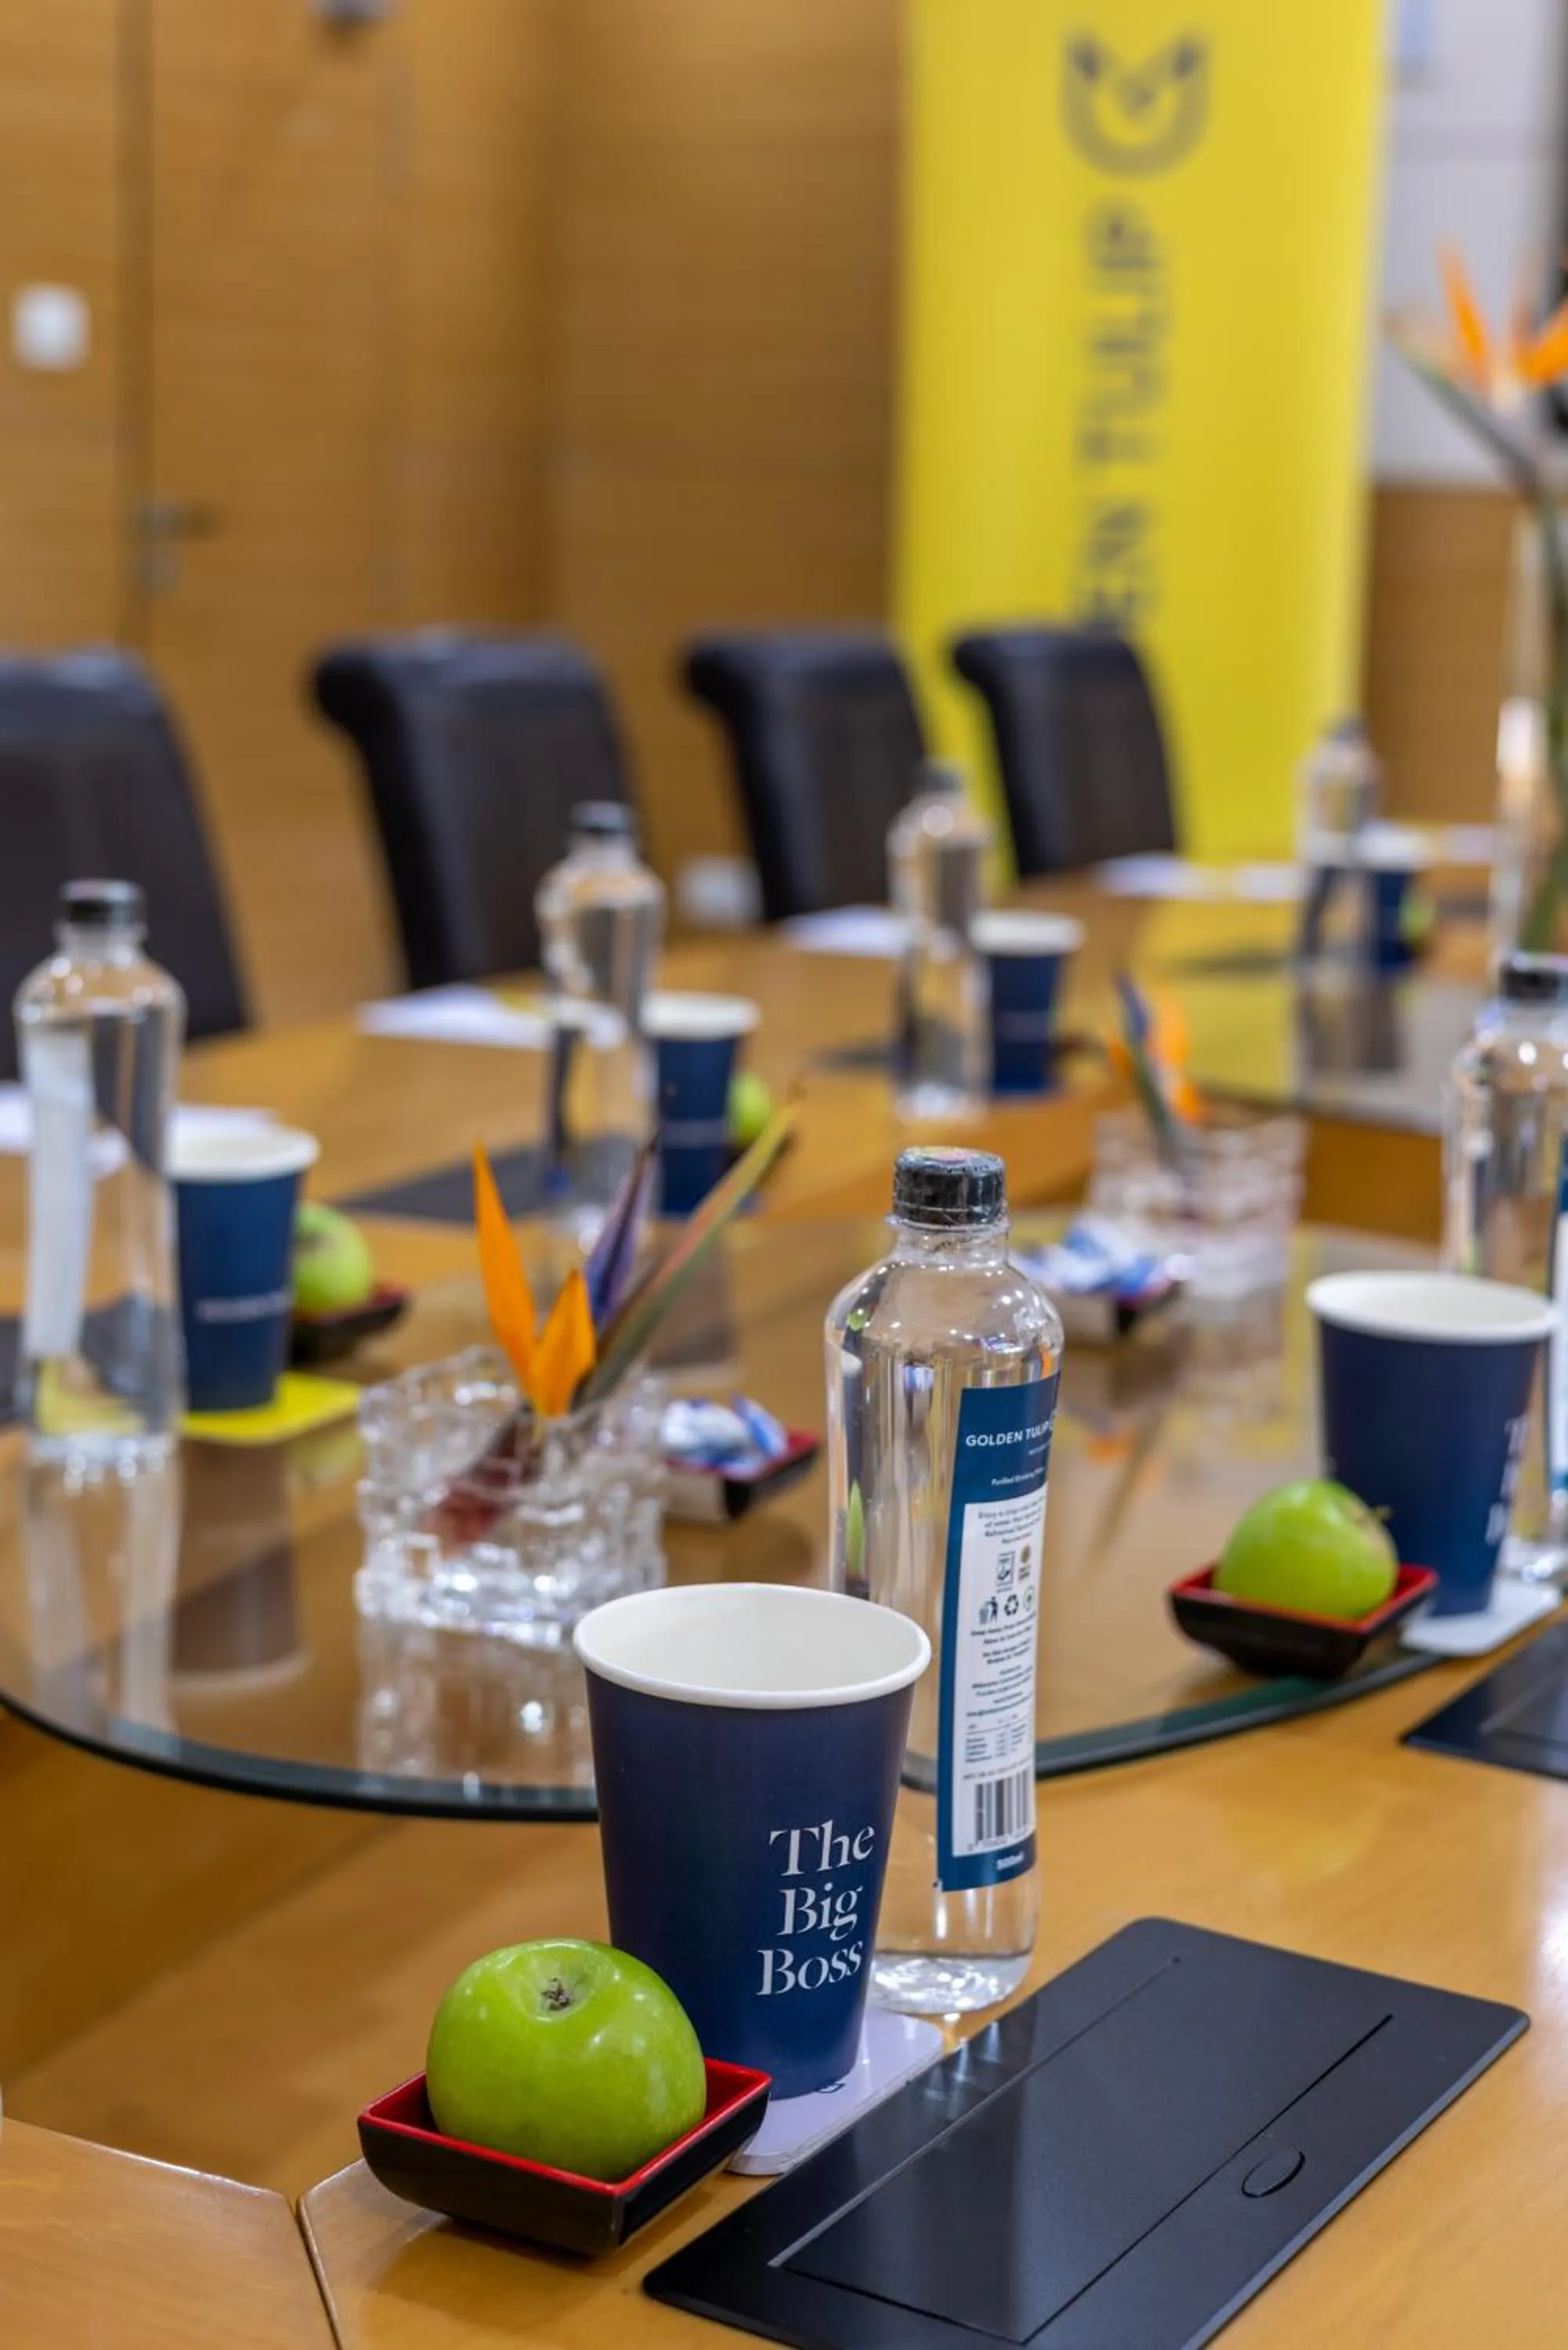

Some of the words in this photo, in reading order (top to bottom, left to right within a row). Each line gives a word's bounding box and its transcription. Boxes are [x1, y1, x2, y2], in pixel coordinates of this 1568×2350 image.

[1076, 199, 1167, 472] TULIP
[966, 1431, 1023, 1447] GOLDEN
[1026, 1420, 1049, 1440] TULIP
[768, 1819, 876, 1876] The
[776, 1882, 864, 1941] Big
[756, 1941, 864, 1996] Boss
